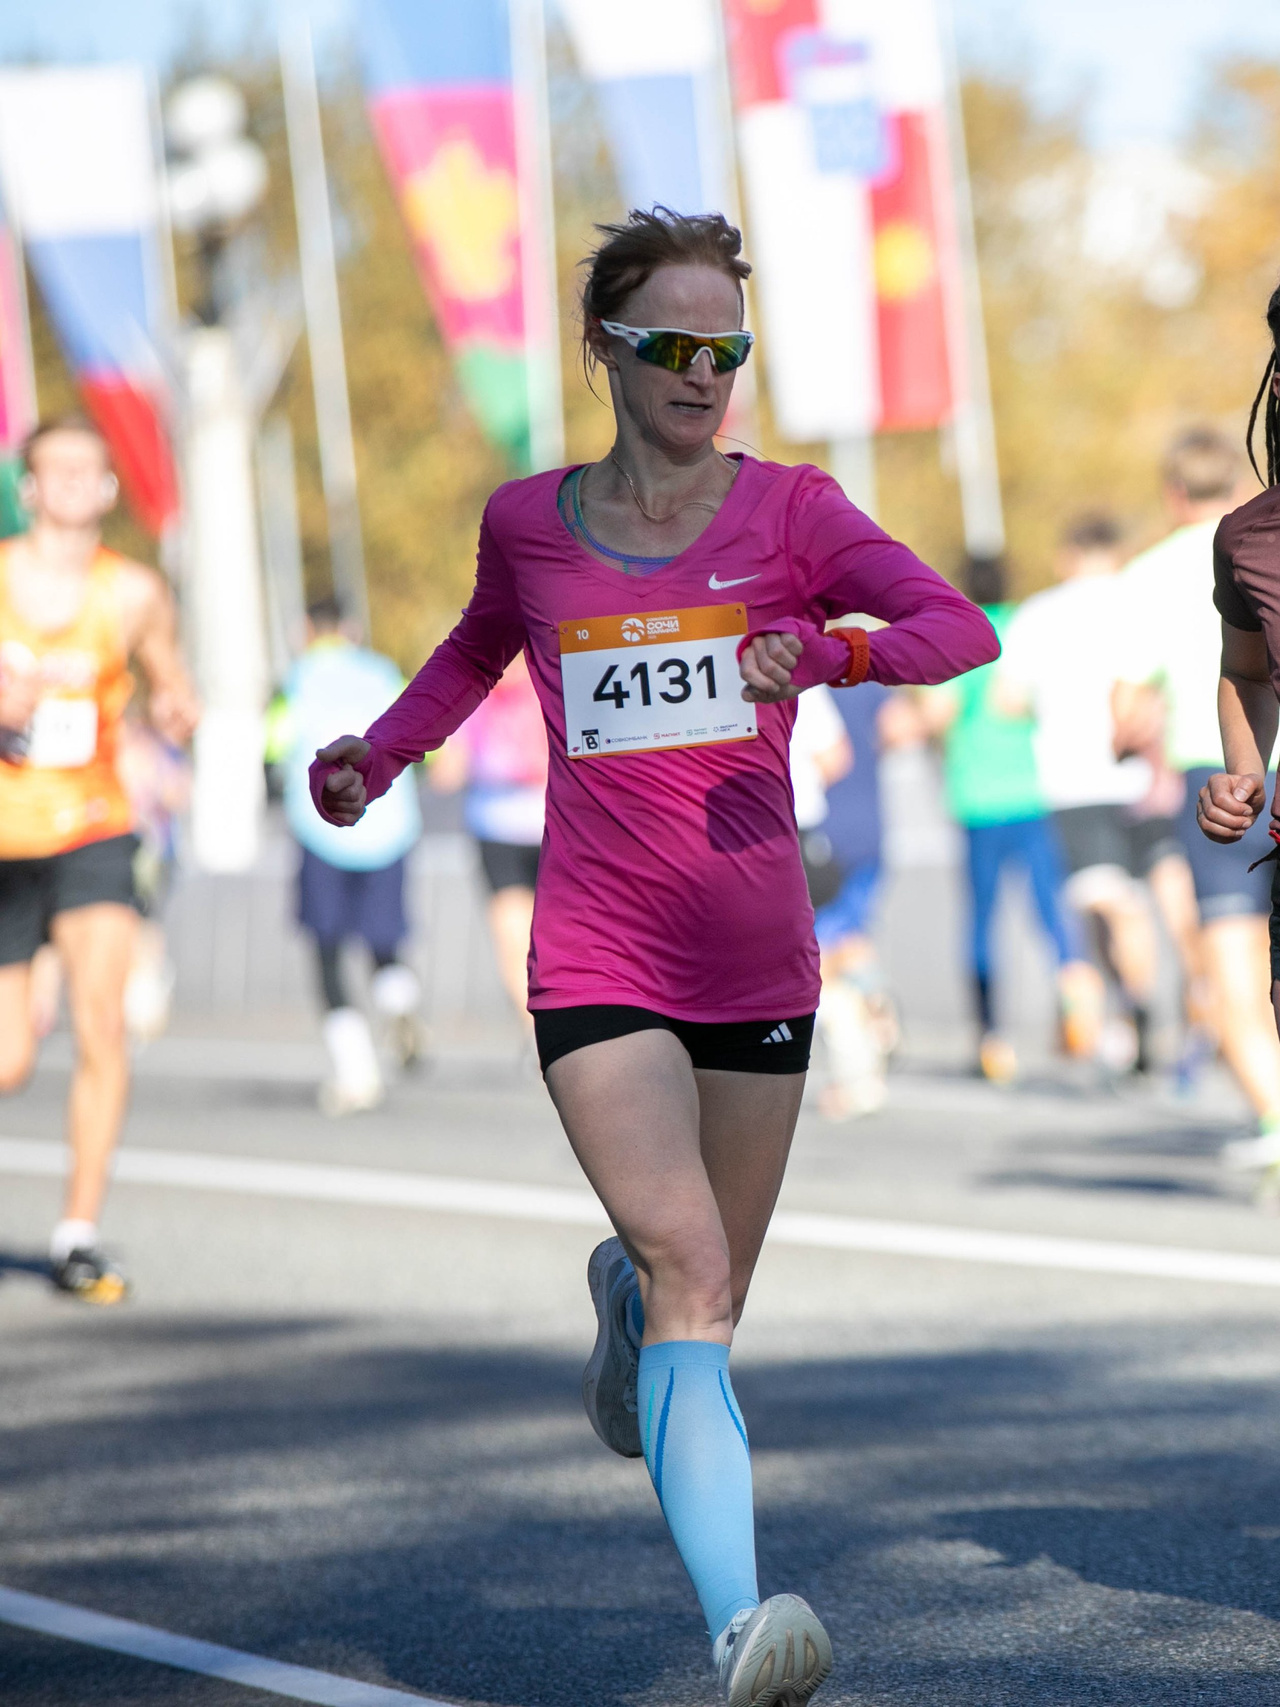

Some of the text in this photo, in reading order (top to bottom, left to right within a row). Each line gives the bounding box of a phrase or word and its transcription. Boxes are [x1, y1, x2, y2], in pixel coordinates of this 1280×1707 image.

[646, 620, 679, 630] СОЧИ
[576, 629, 589, 640] 10
[593, 655, 717, 709] 4131
[611, 735, 648, 743] СОВКОМБАНК
